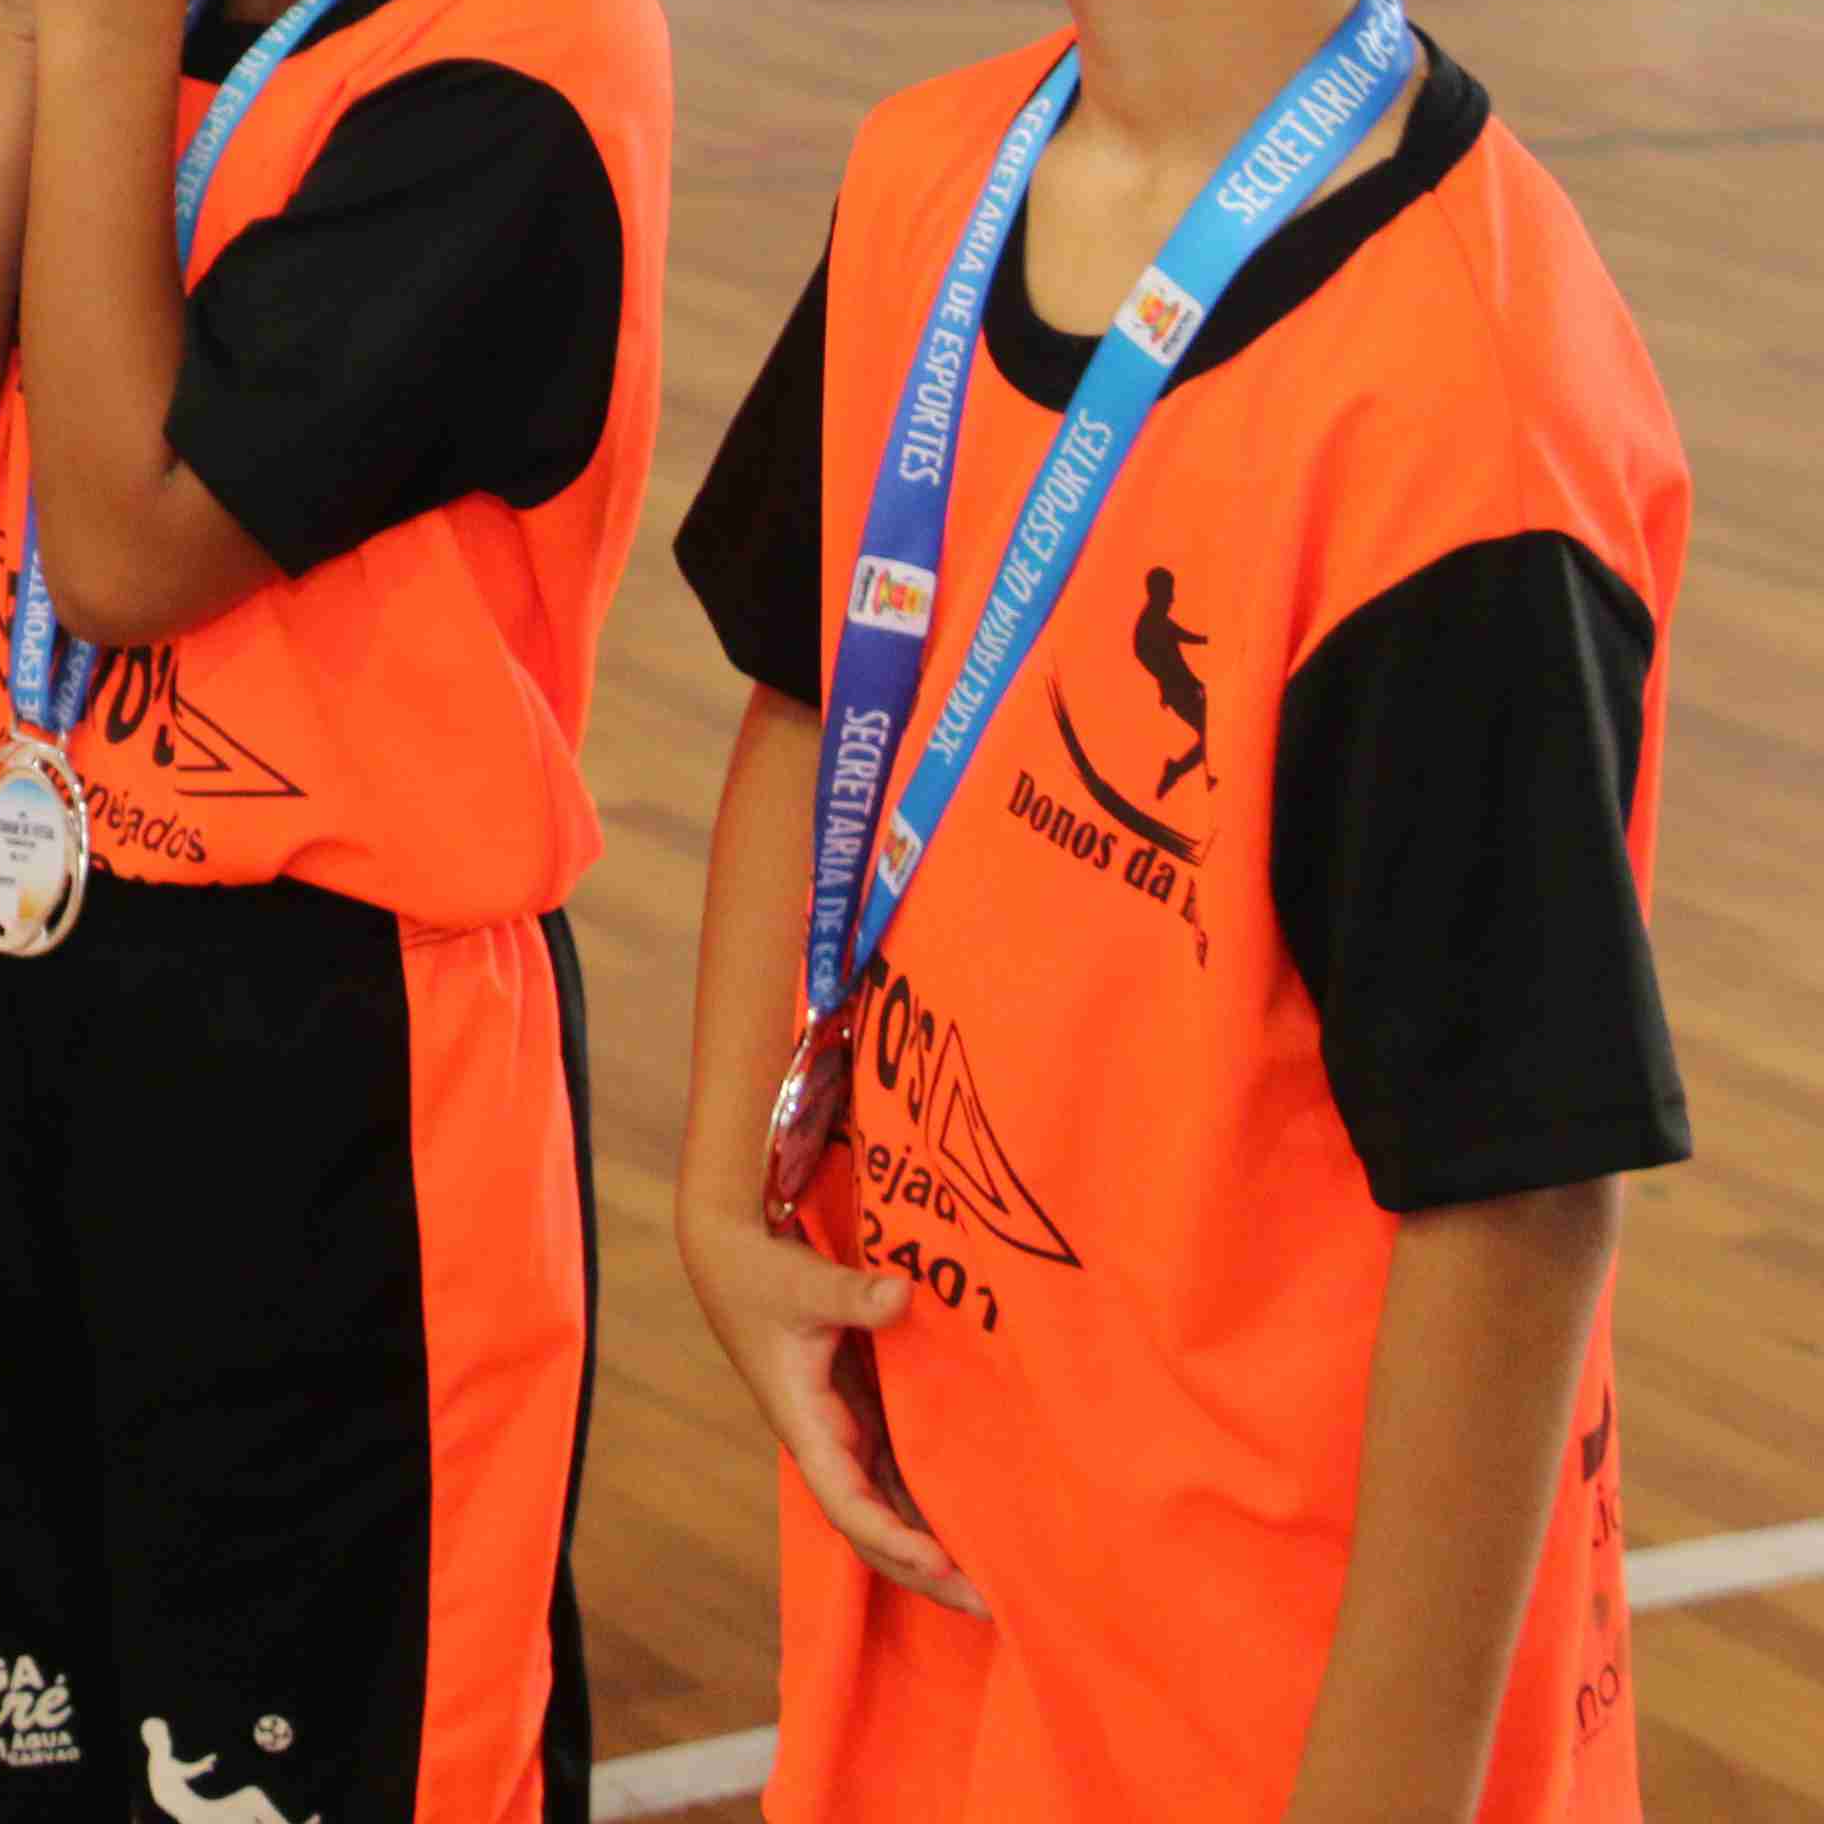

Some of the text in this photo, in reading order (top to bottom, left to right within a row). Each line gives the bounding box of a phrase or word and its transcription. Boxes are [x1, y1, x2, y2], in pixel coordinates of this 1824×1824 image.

[1216, 53, 1378, 225] SECRETARIA
[898, 95, 1052, 488] SECRETARIA DE ESPORTES
[1020, 408, 1114, 564] ESPORTES
[818, 706, 891, 889] SECRETARIA
[1008, 768, 1119, 871] Donos
[1123, 847, 1177, 905] da
